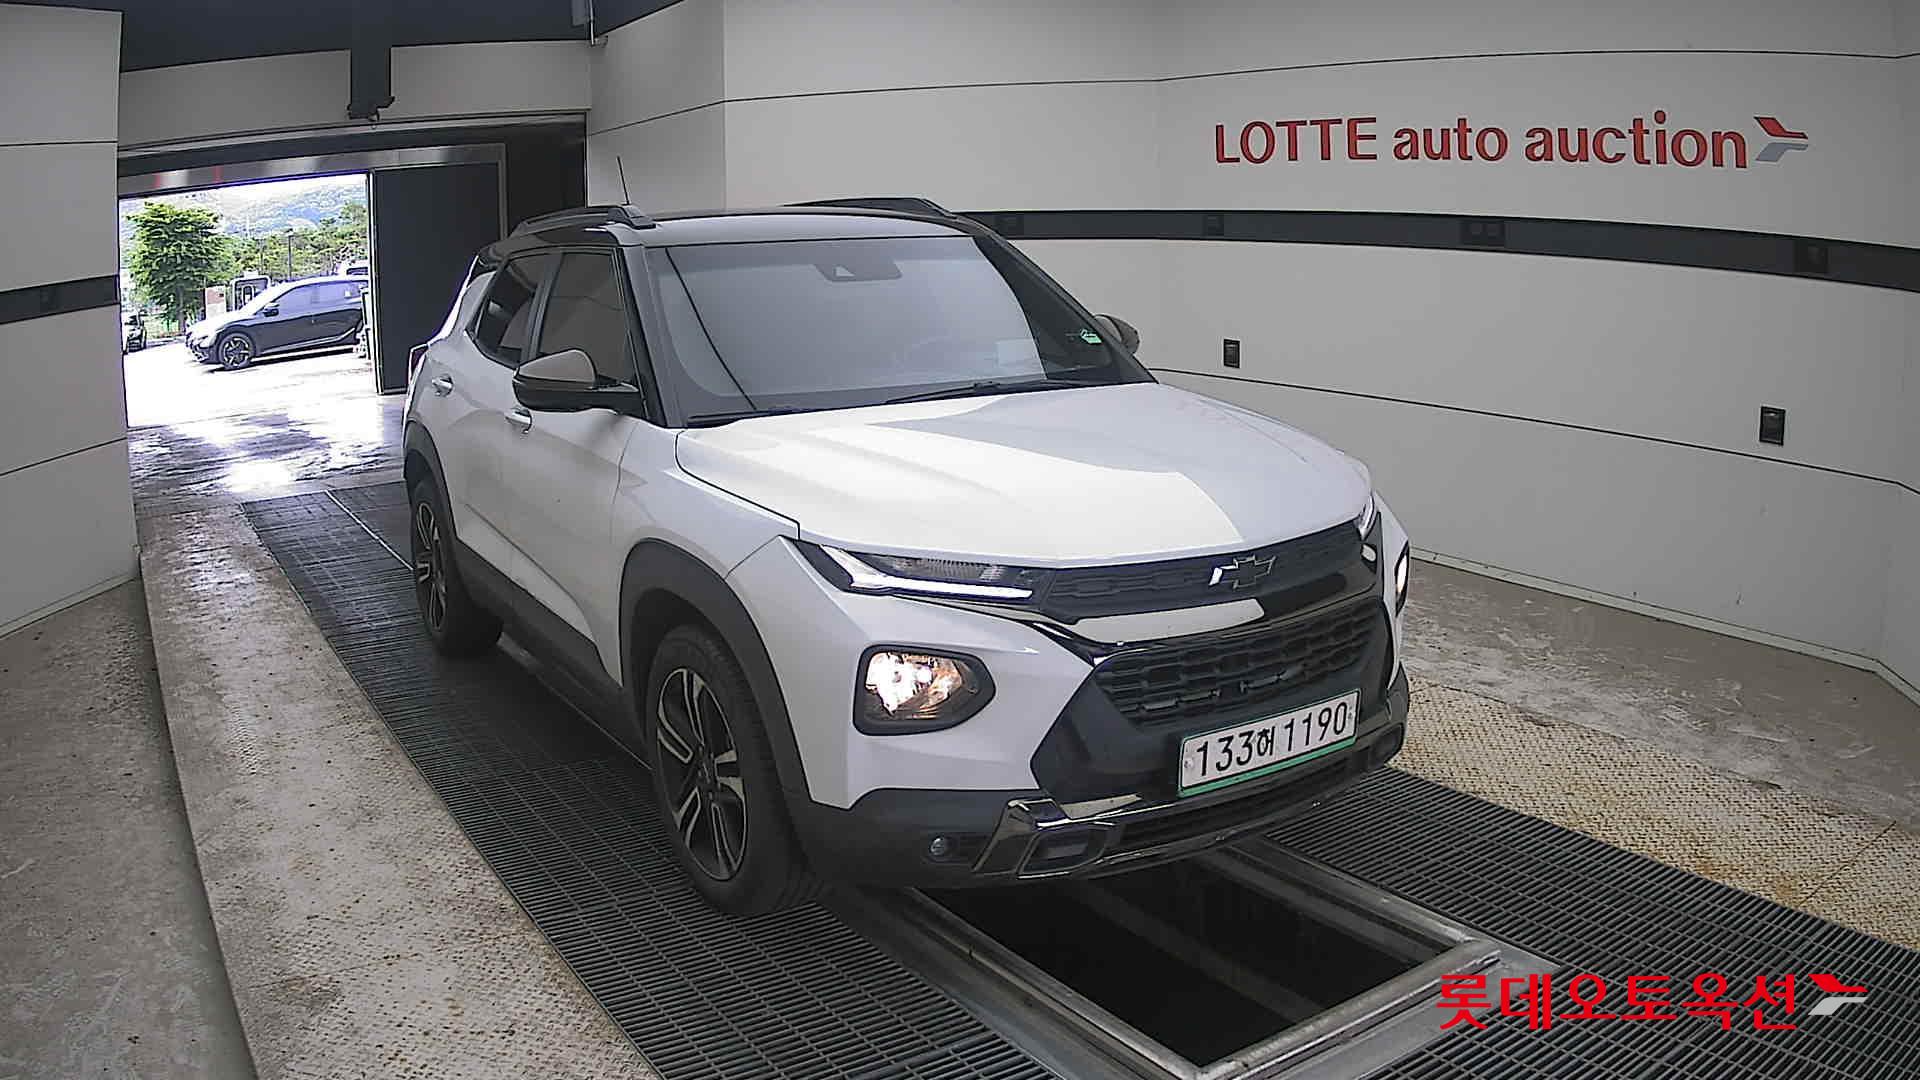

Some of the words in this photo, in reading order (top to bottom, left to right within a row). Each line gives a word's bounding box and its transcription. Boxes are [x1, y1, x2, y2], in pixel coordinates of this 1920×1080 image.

[1215, 117, 1377, 163] LOTTE
[1392, 118, 1508, 162] auto
[1525, 110, 1748, 168] auction
